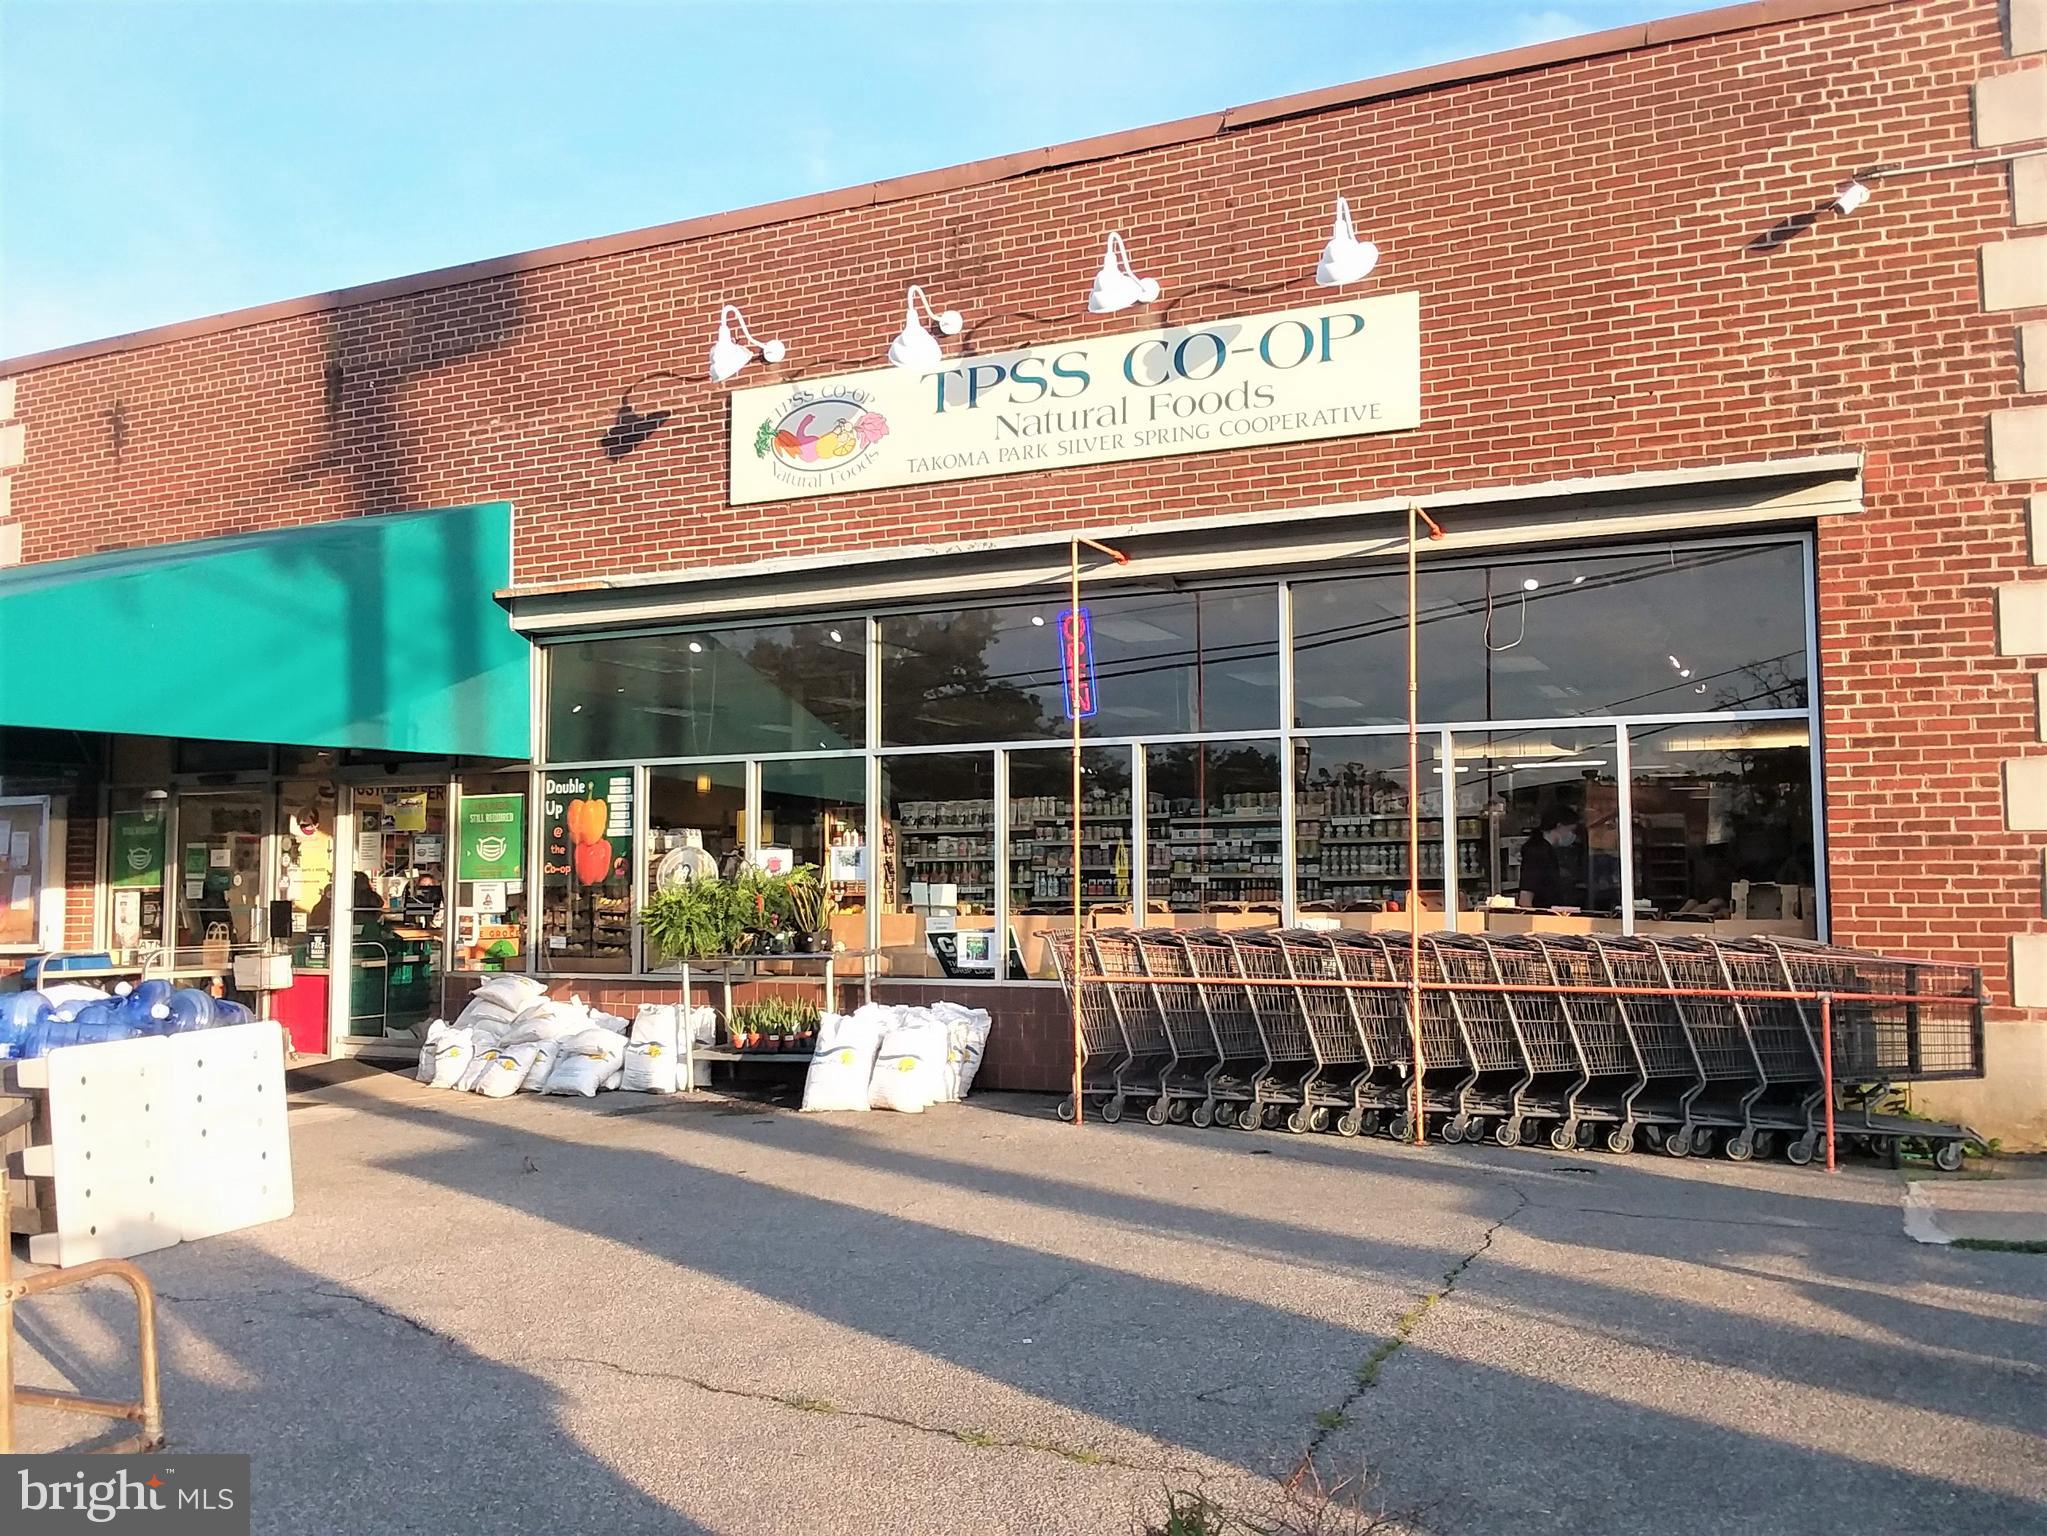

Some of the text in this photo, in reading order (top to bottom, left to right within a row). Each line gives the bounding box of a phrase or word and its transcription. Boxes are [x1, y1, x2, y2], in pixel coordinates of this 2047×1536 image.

[920, 313, 1365, 414] TPSS CO-OP
[773, 384, 876, 418] TPSS CO-OP
[995, 380, 1275, 441] Natural Foods
[906, 403, 1383, 474] TAKOMA PARK SILVER SPRING COOPERATIVE
[772, 451, 879, 488] Natural Foods
[546, 778, 585, 794] Double
[545, 800, 563, 819] Up
[553, 827, 563, 838] @
[550, 844, 566, 854] the
[544, 862, 571, 875] Co-op
